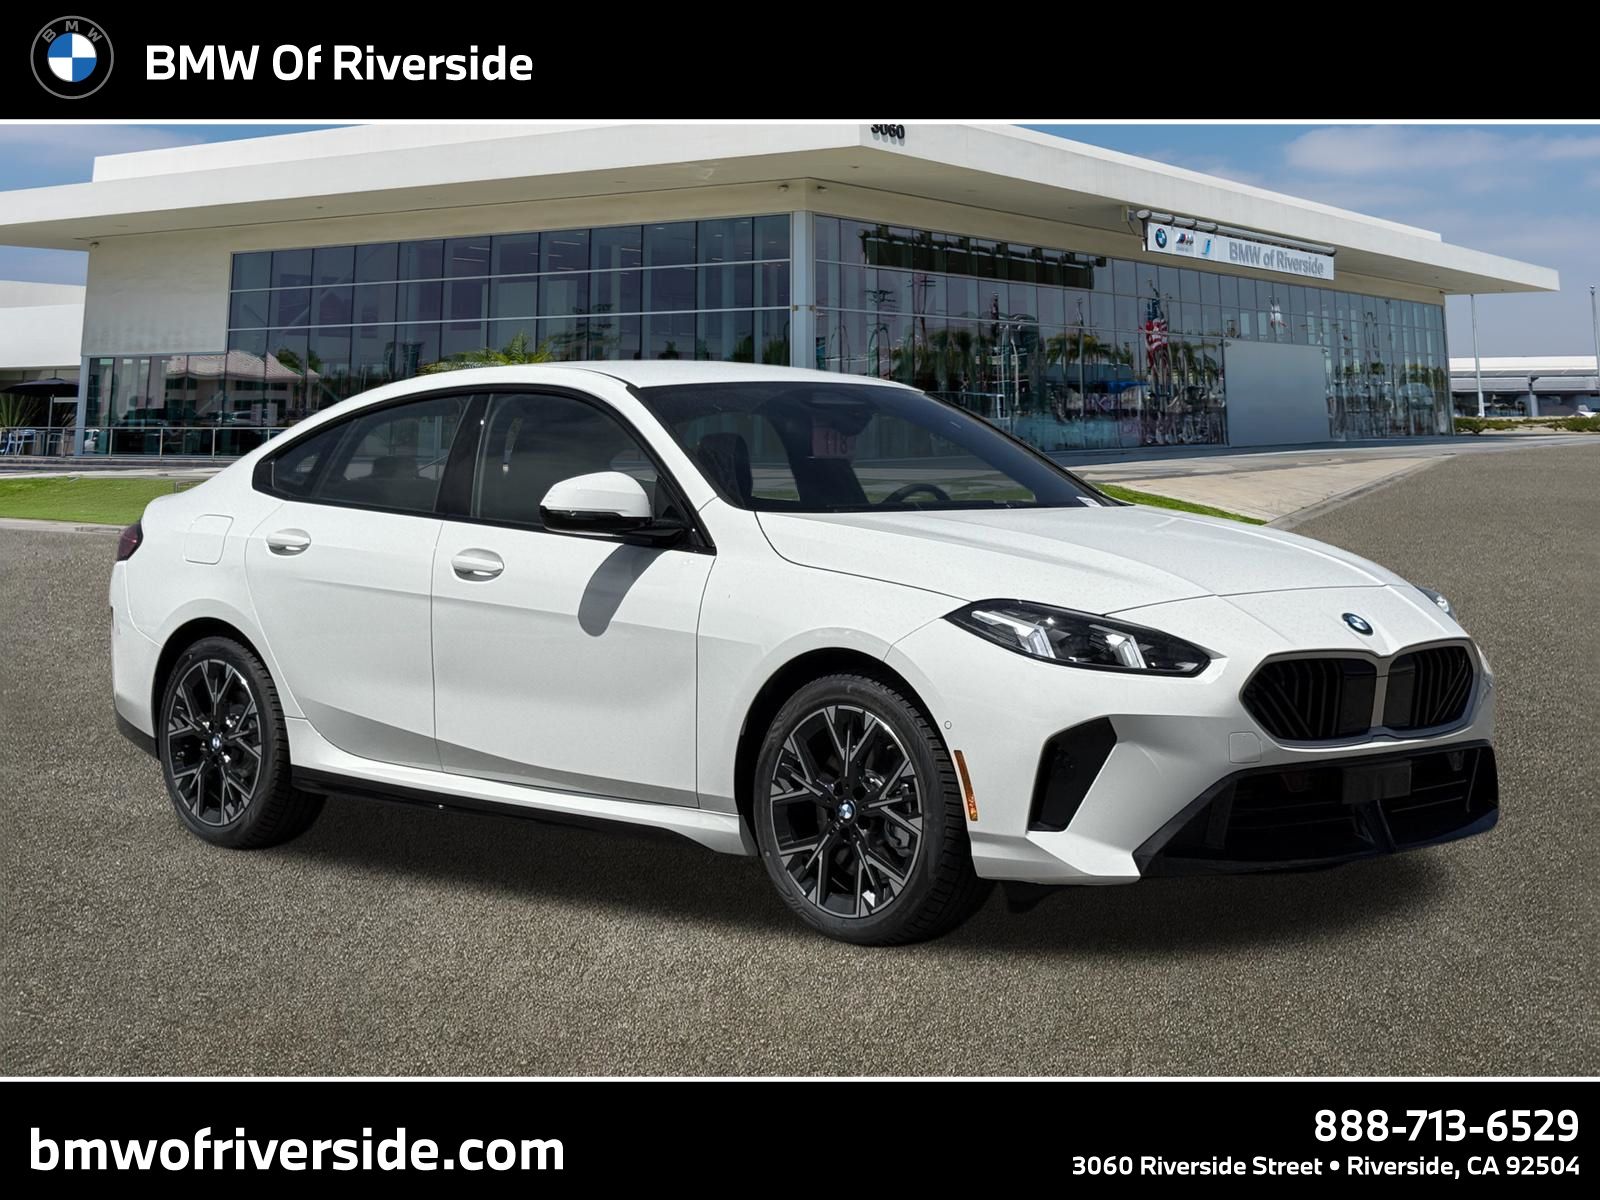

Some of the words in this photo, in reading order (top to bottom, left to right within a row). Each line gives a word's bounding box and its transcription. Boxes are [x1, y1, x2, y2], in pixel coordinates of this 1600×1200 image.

[1229, 241, 1261, 264] BMW
[1263, 249, 1275, 267] of
[1276, 251, 1324, 275] Riverside
